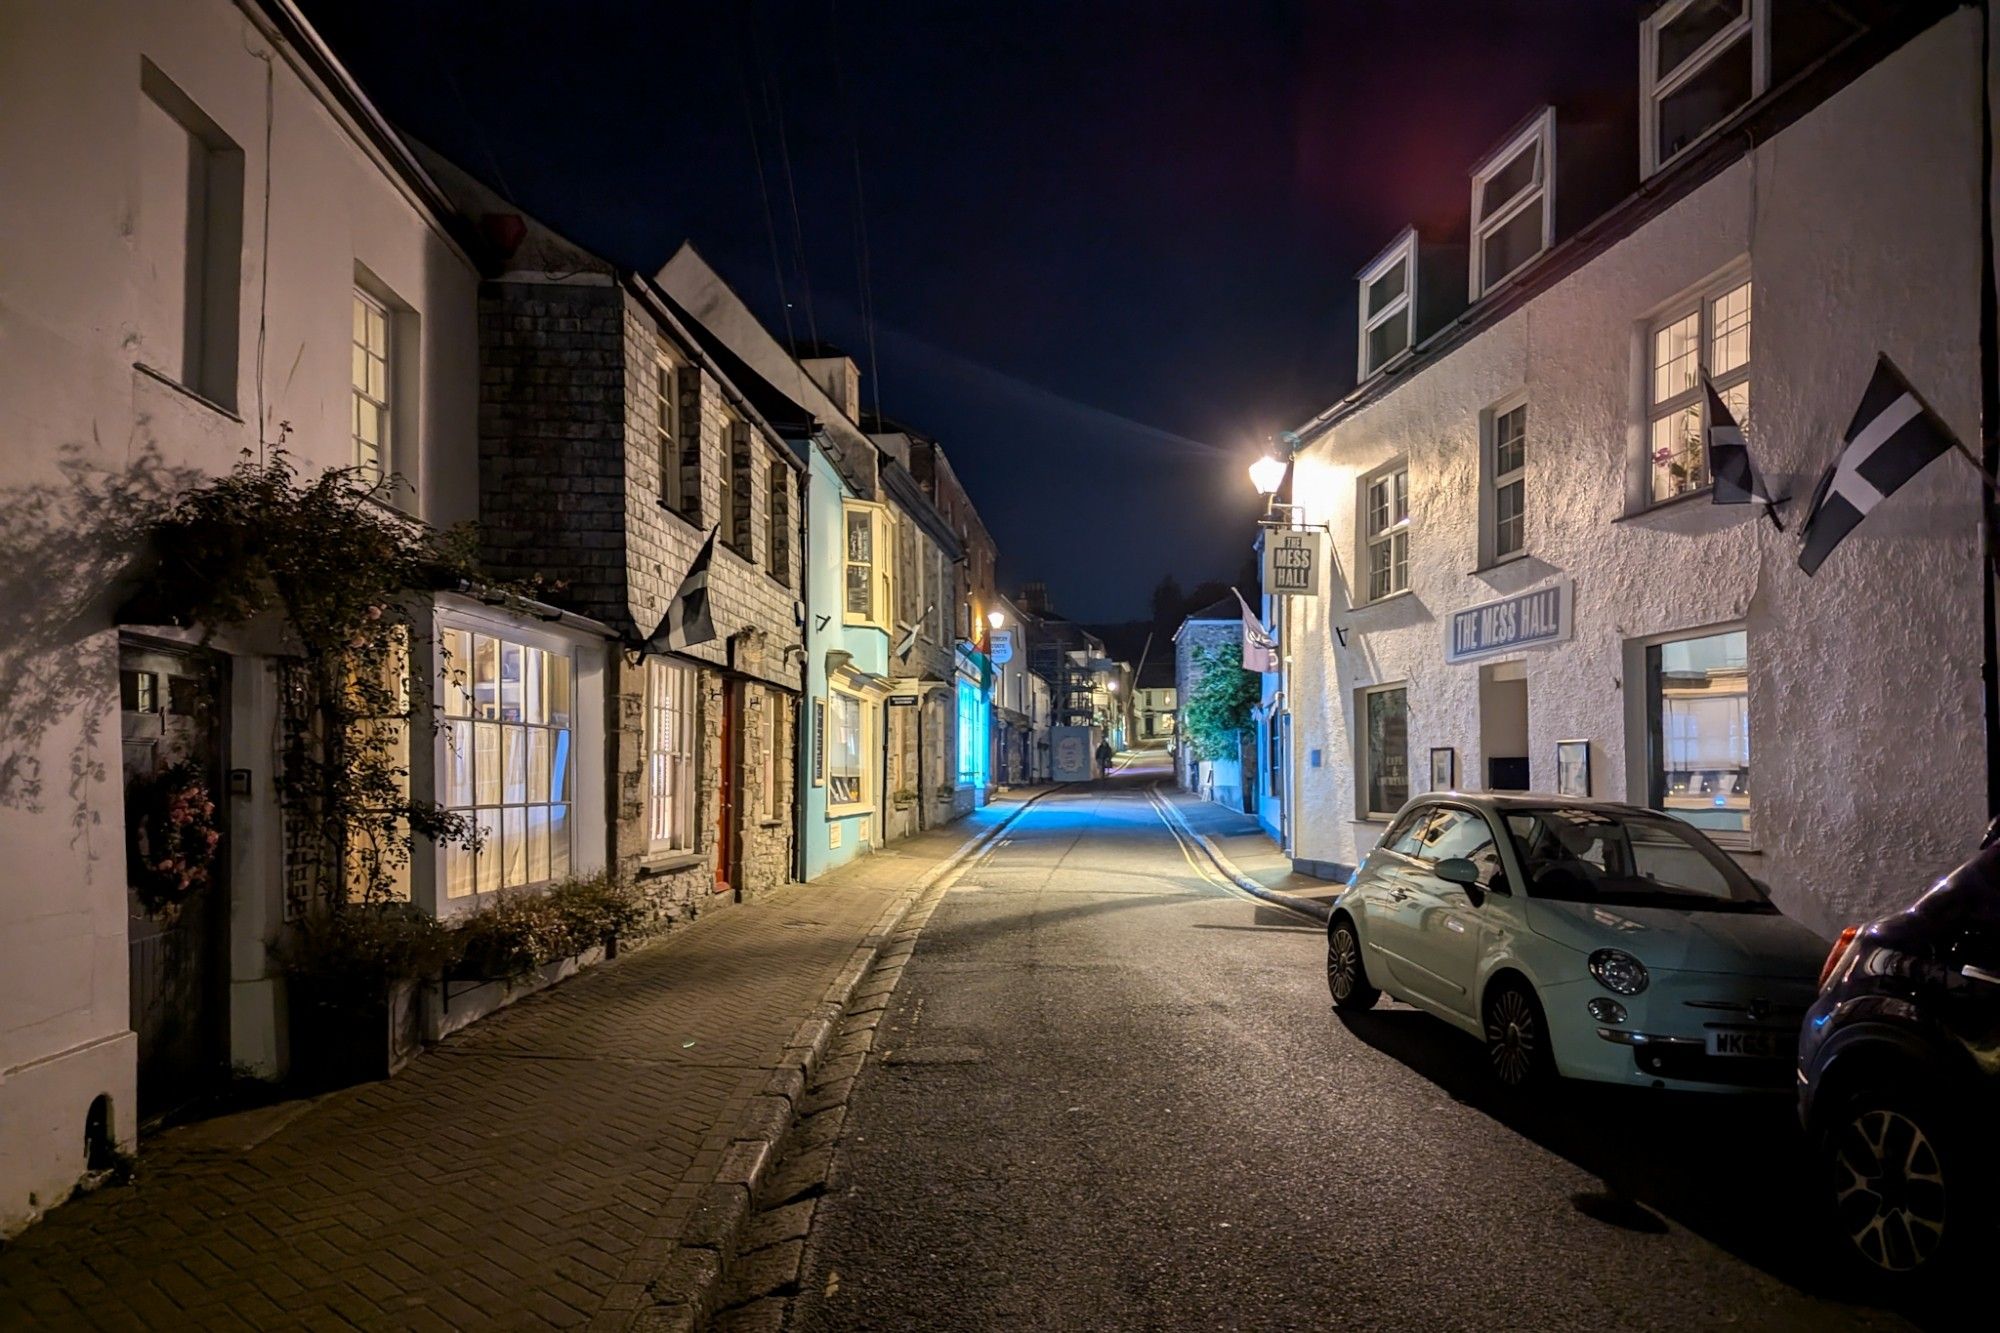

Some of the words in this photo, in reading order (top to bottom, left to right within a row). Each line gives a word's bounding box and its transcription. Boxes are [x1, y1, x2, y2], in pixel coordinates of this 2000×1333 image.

[1286, 537, 1301, 548] THE
[1276, 549, 1310, 568] MESS
[1277, 568, 1307, 587] HALL
[1456, 611, 1479, 653] THE
[1481, 602, 1516, 648] MESS
[1520, 591, 1557, 639] HALL
